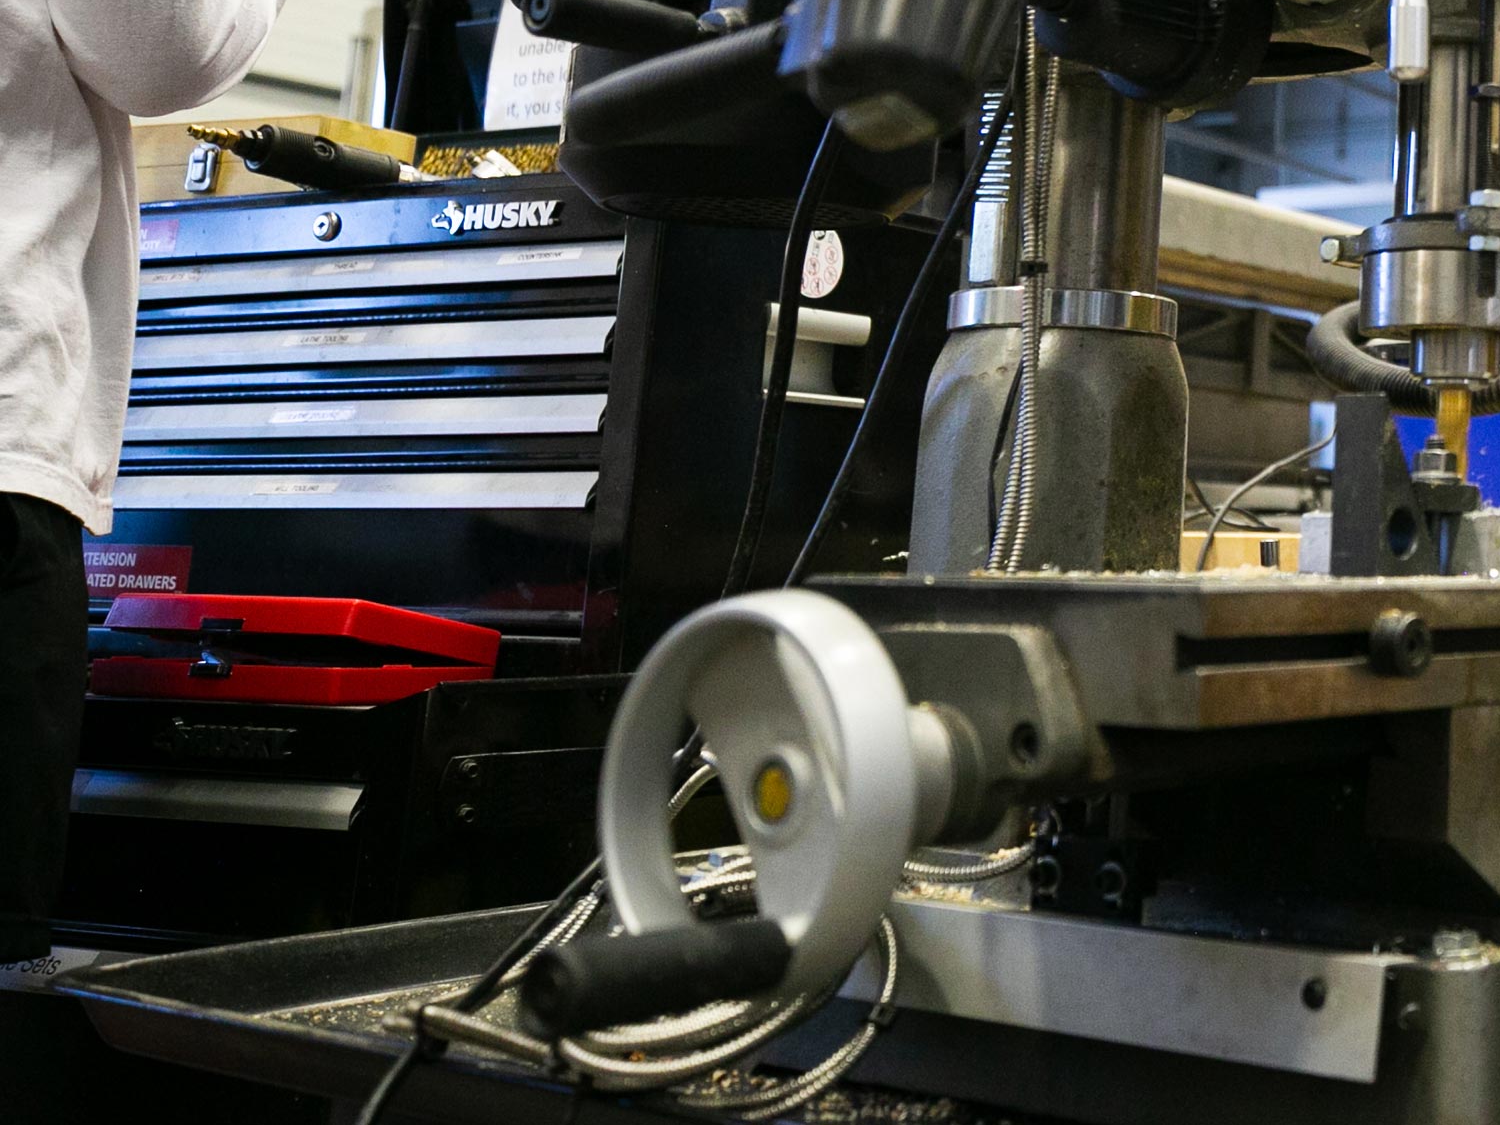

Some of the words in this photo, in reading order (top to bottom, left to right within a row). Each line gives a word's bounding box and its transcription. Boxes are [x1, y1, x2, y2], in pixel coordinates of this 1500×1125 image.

[519, 38, 567, 57] unable
[513, 72, 528, 87] to
[531, 67, 555, 84] the
[506, 102, 520, 120] it,
[524, 102, 550, 119] you
[118, 574, 178, 591] DRAWERS
